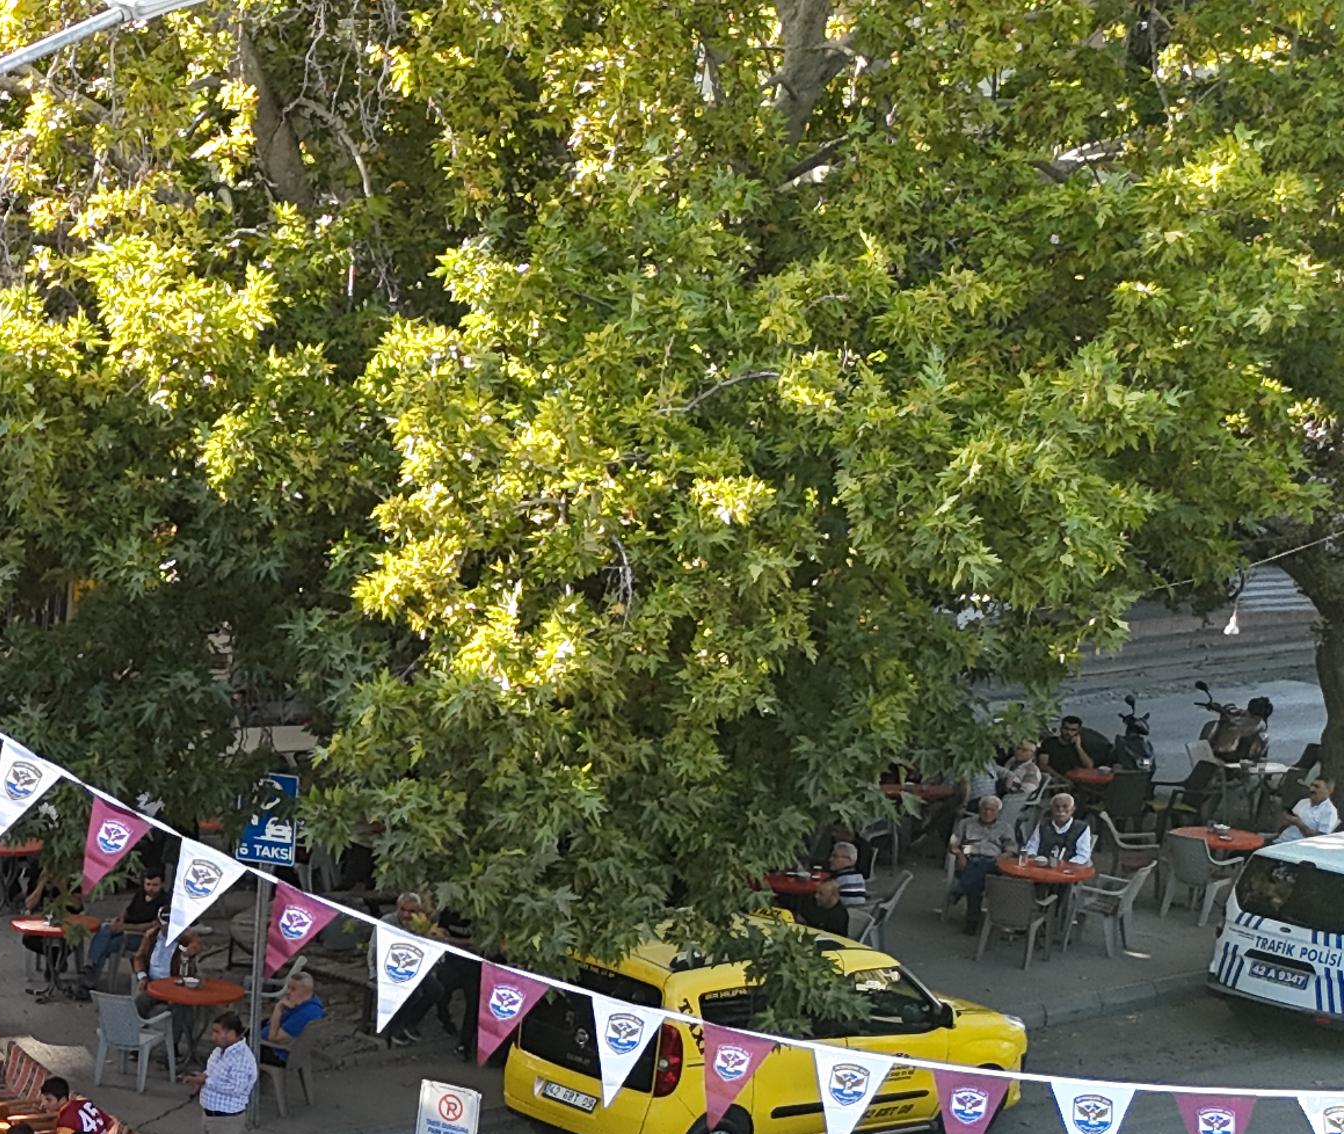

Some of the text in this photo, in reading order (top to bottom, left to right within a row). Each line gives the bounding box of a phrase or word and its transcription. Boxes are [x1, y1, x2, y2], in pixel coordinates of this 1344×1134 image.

[1255, 935, 1343, 968] TRAFİK POLİSİ
[1252, 963, 1305, 986] 42 A 9347
